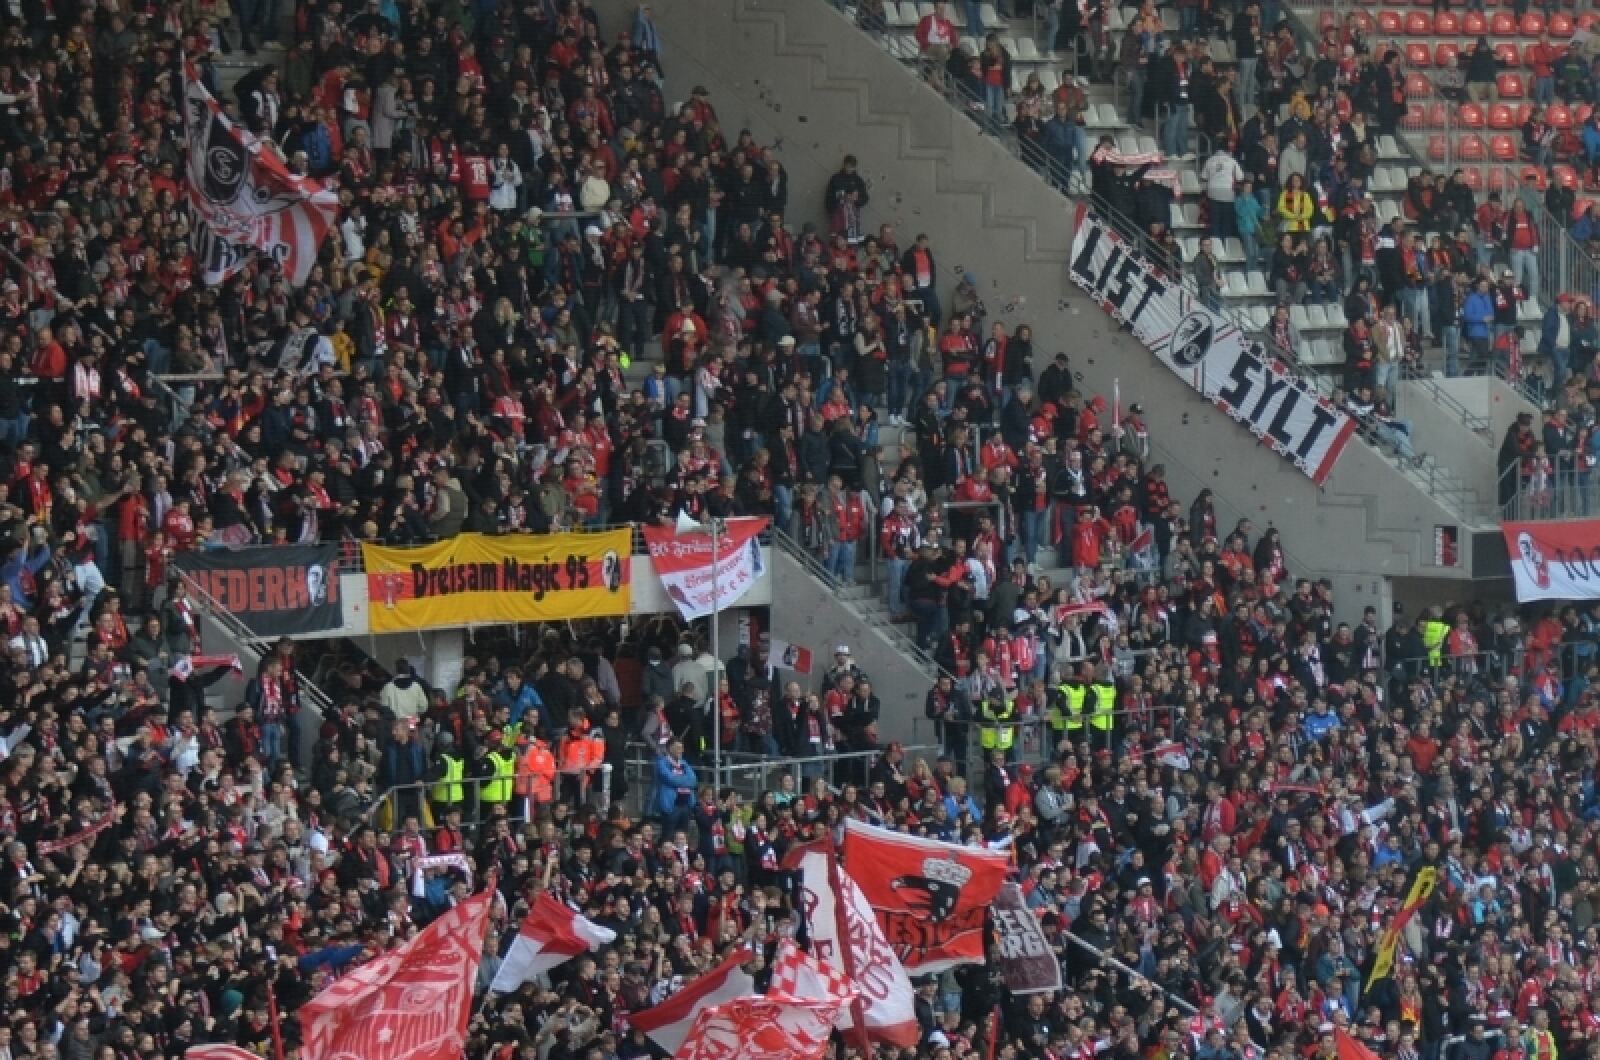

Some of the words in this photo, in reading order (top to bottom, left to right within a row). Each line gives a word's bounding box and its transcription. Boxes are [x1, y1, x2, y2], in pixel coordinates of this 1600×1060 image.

[1071, 224, 1167, 323] LIST
[1219, 351, 1337, 458] SYLT
[411, 557, 497, 598] Dreisam
[503, 556, 560, 600] Magic
[566, 554, 588, 588] 95
